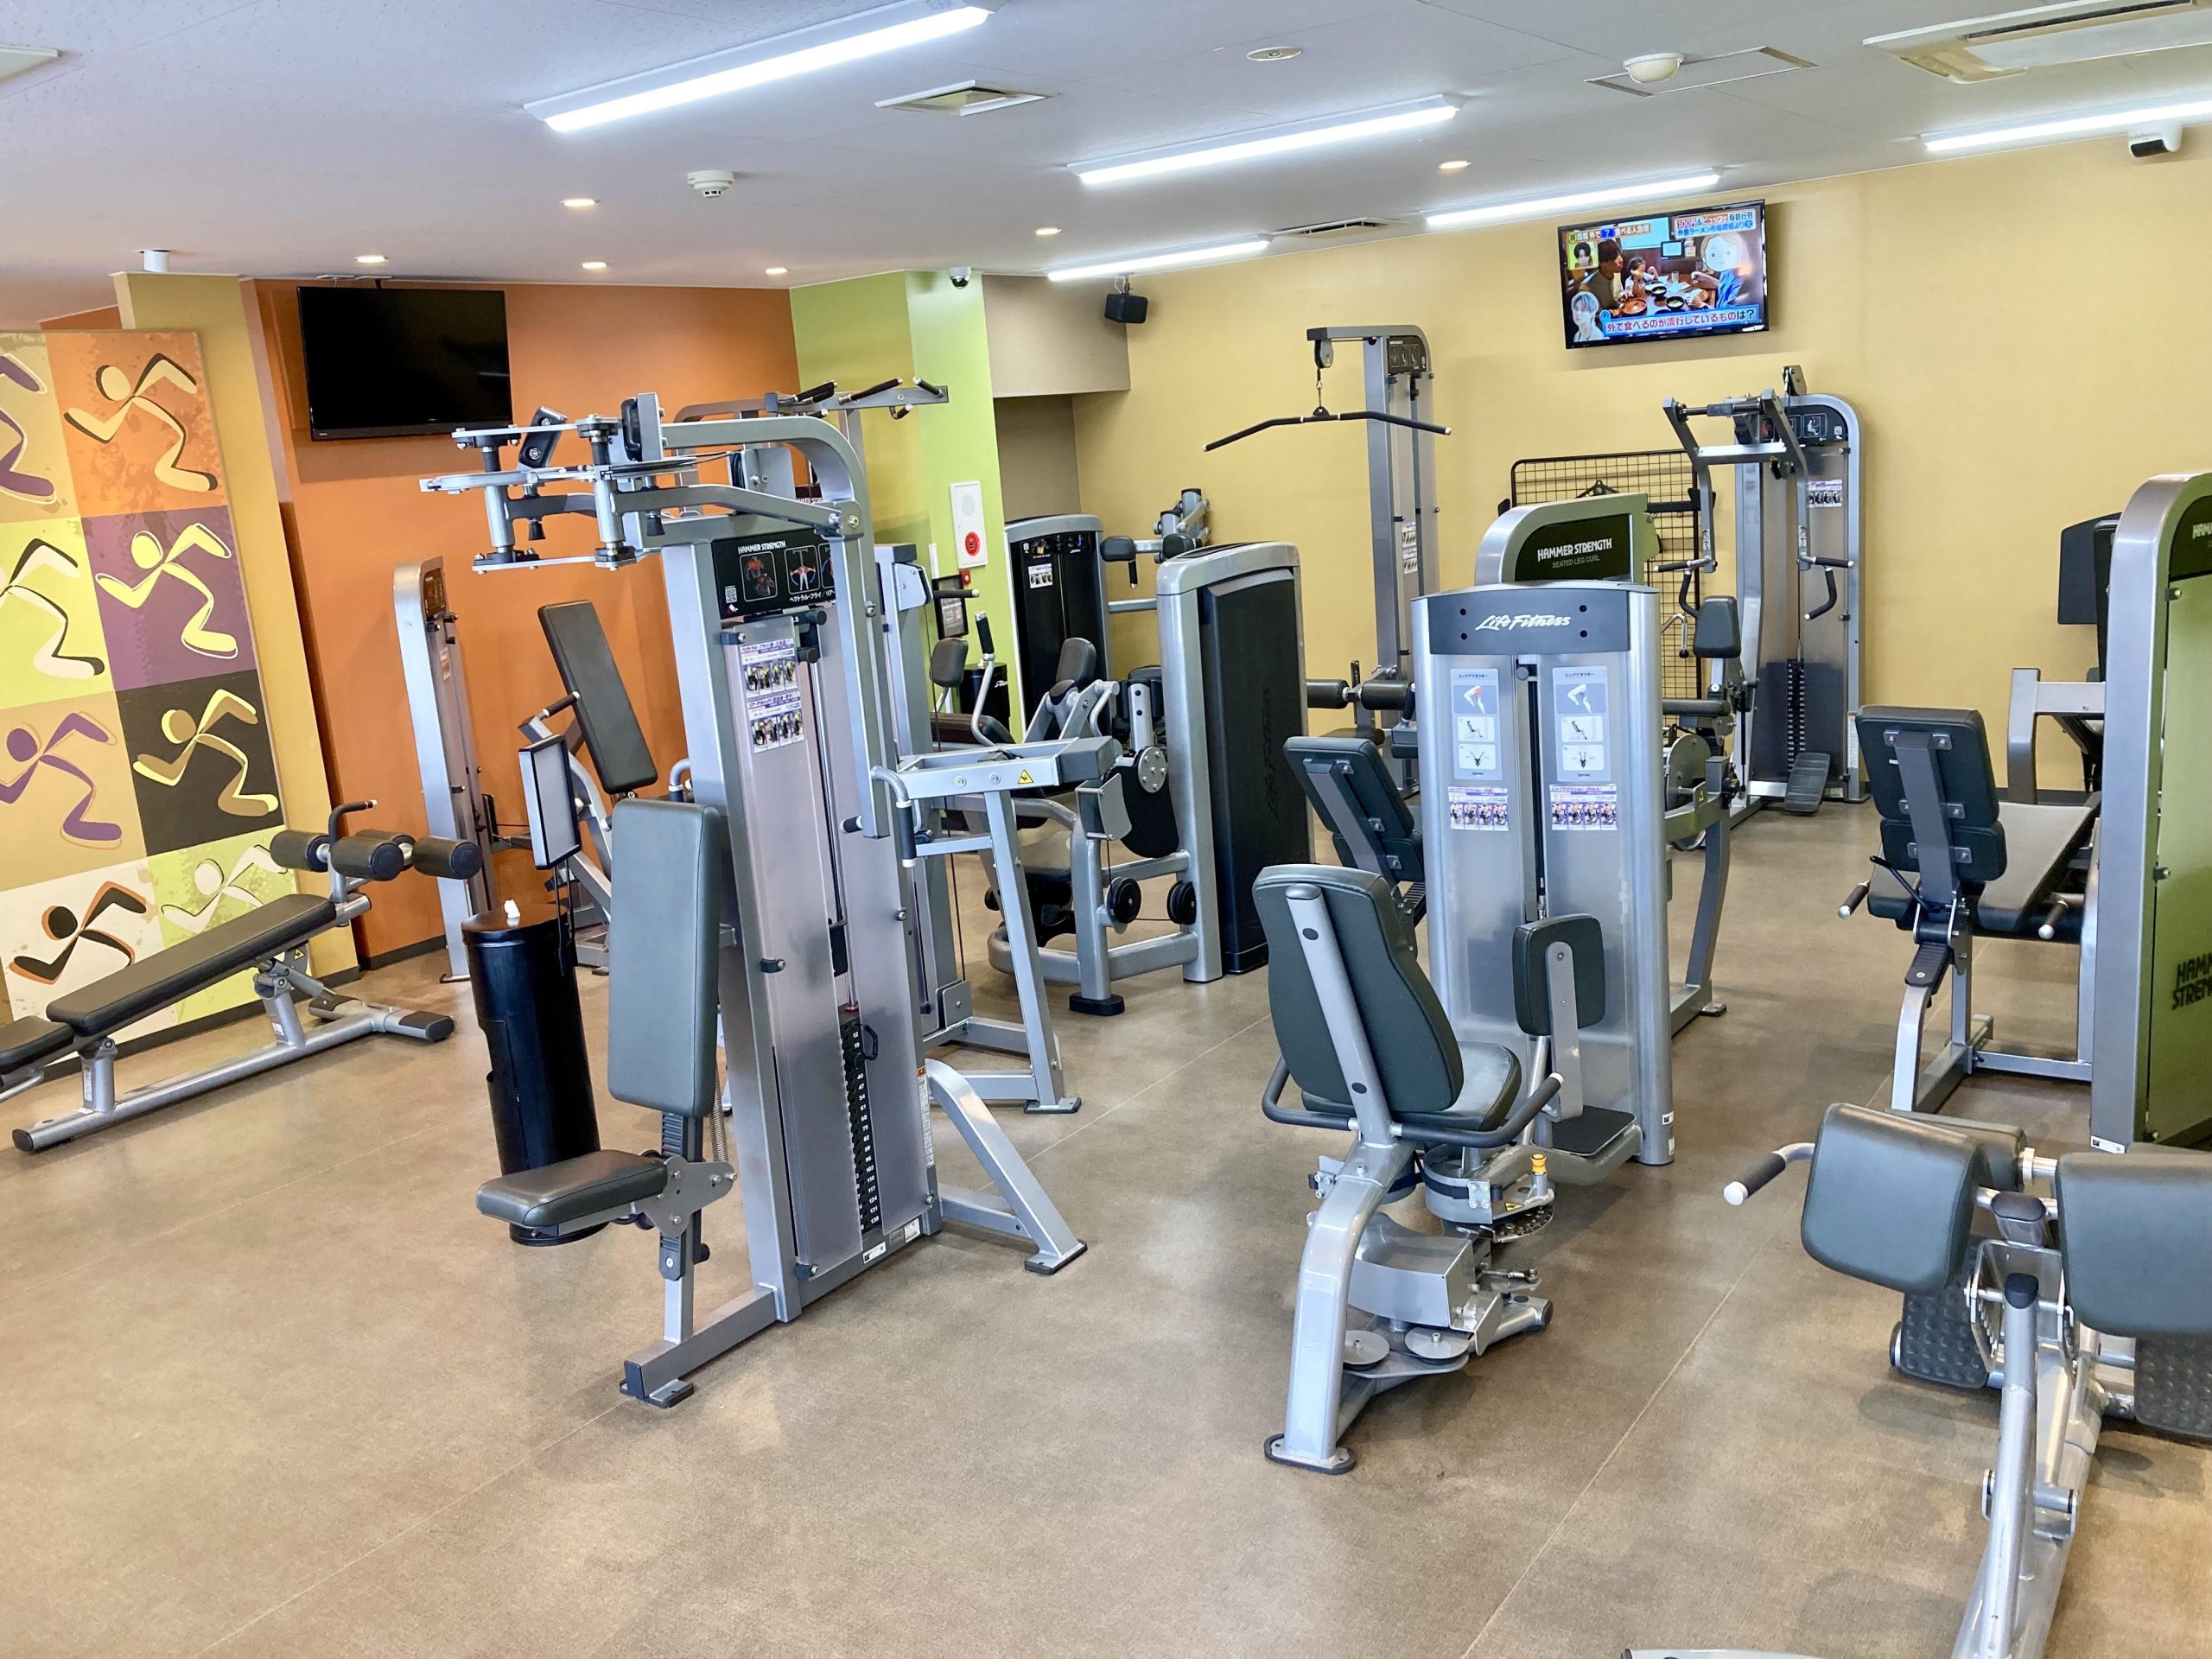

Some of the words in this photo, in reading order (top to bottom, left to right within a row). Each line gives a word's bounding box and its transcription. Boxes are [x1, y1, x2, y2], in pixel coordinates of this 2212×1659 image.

[738, 544, 761, 555] HAMMER
[762, 540, 786, 551] STRENGTH
[1537, 544, 1573, 562] HAMMER
[1574, 538, 1612, 555] STRENGTH
[1552, 558, 1573, 569] SEATED
[1475, 615, 1510, 631] Life
[1509, 614, 1572, 631] Fitness
